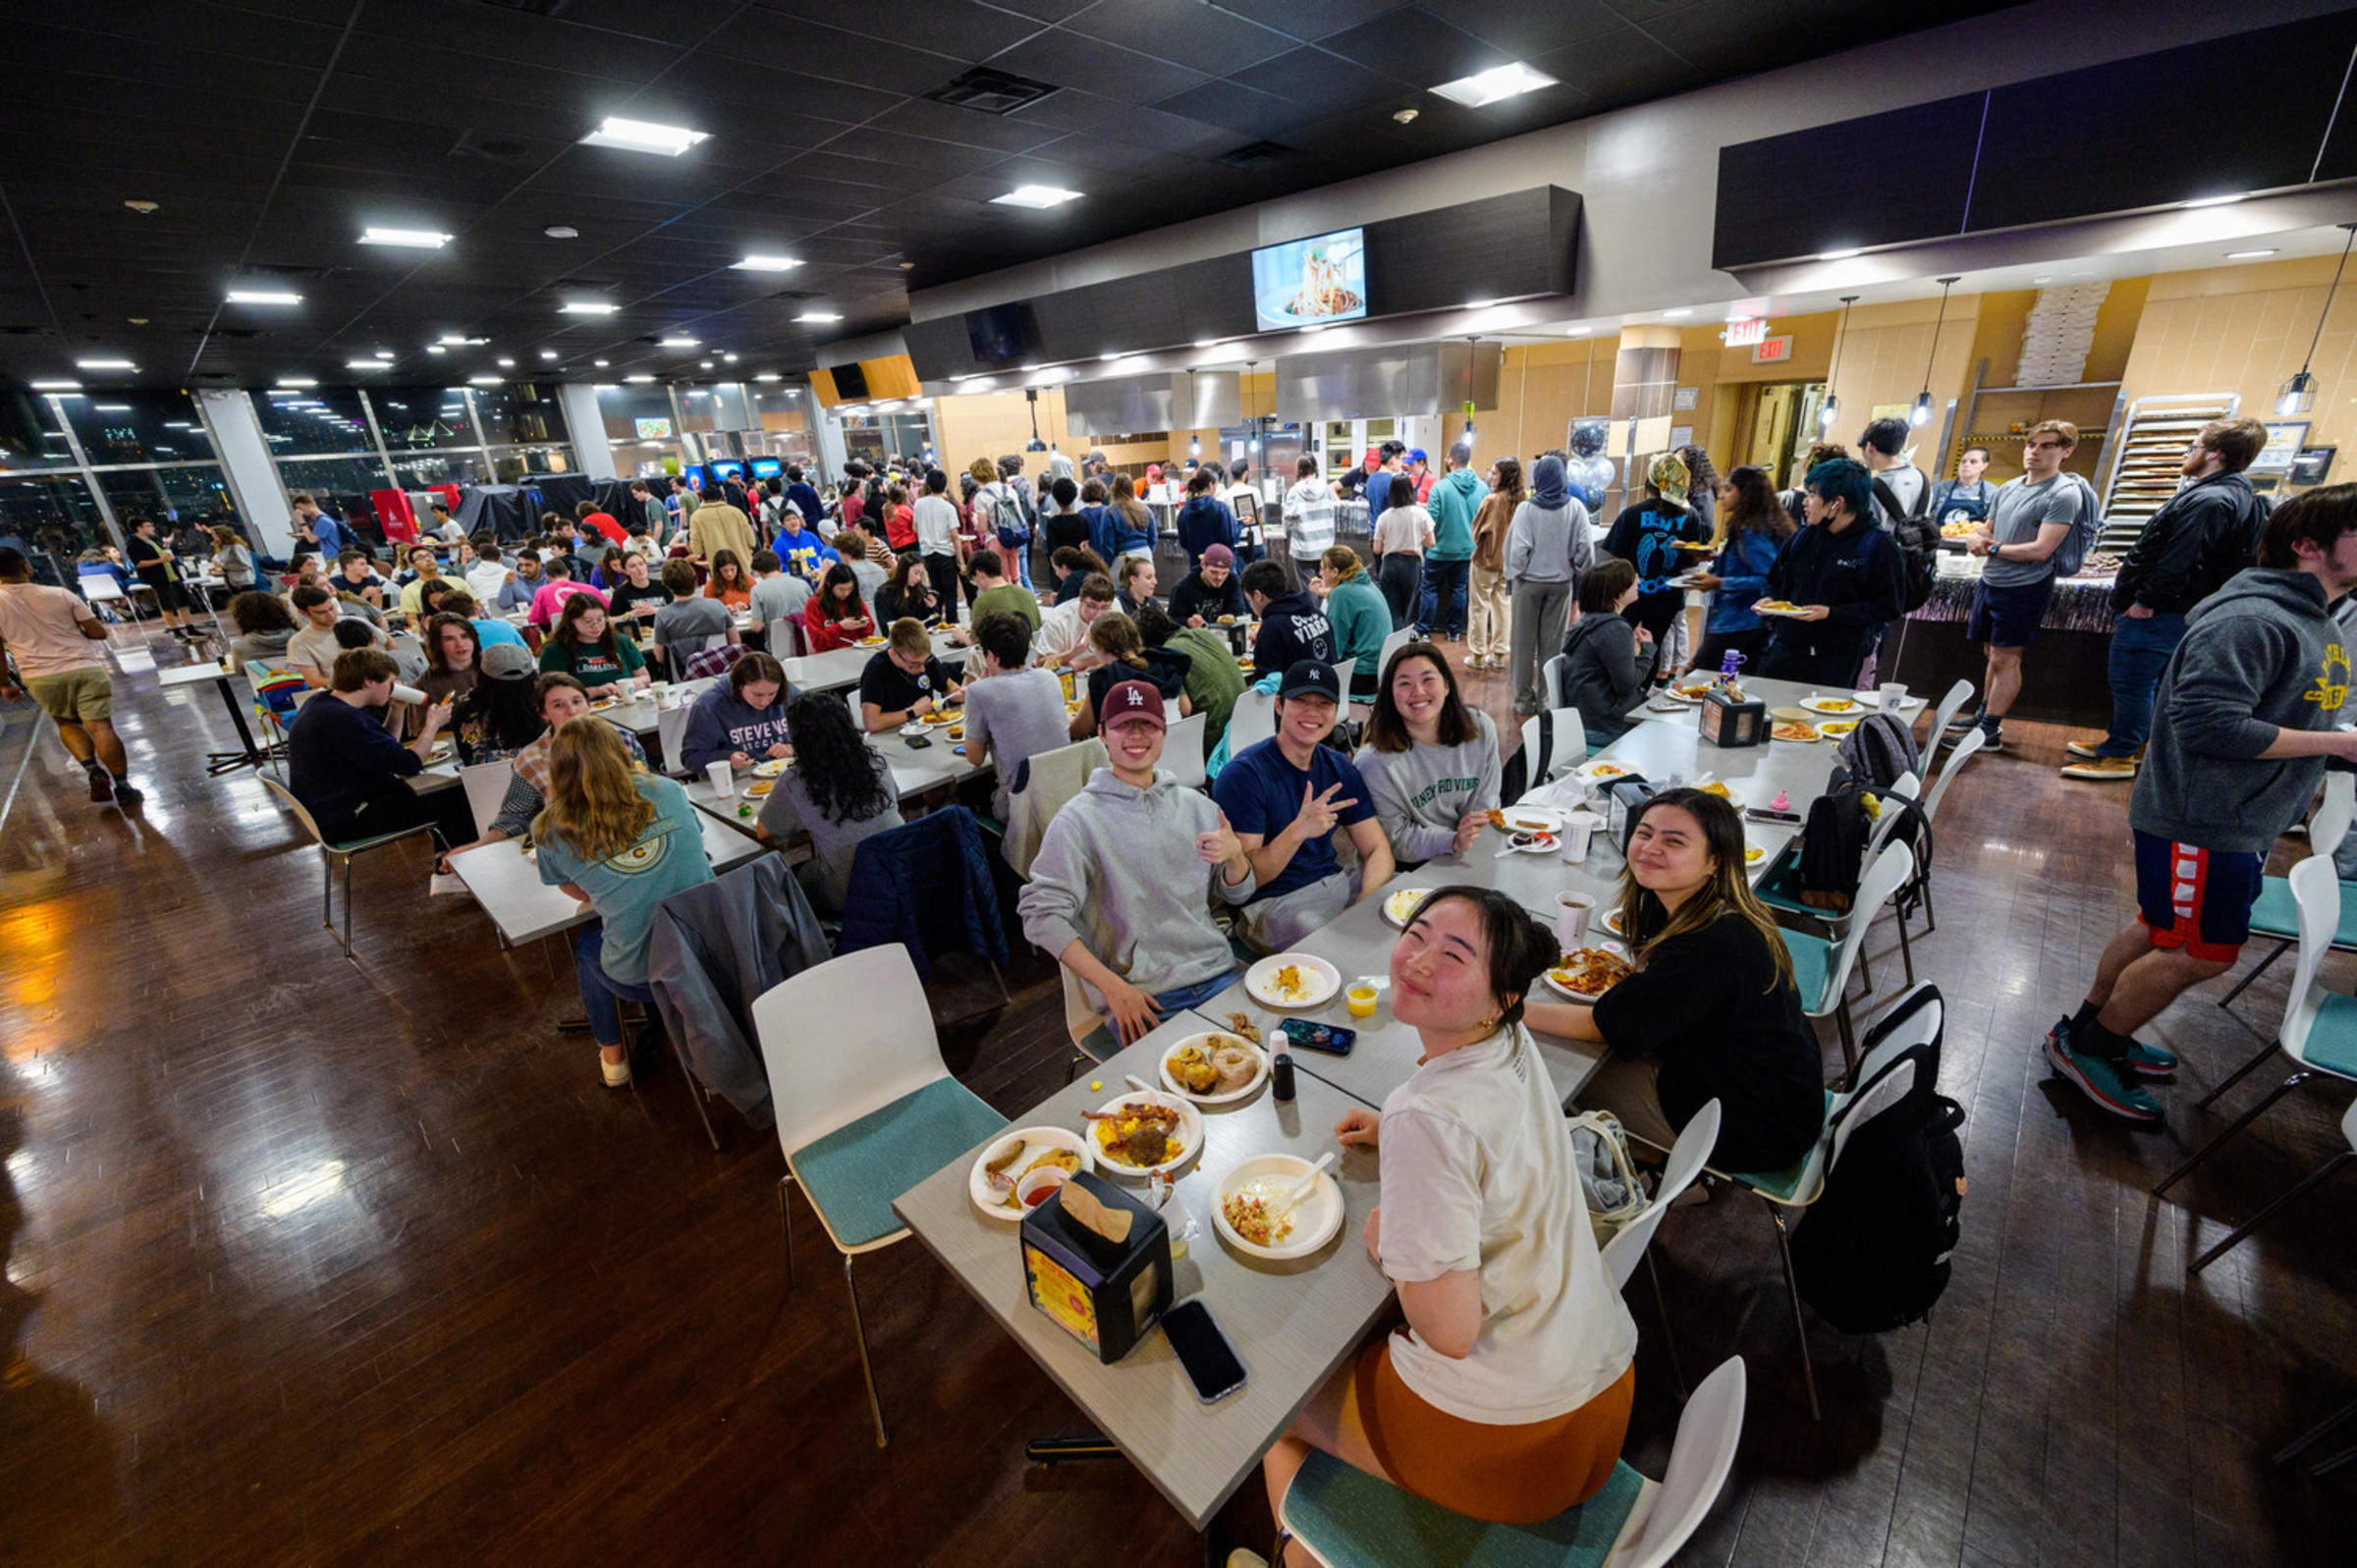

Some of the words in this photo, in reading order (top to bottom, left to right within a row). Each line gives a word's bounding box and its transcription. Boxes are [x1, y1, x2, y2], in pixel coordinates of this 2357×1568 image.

[1733, 319, 1763, 342] EXIT
[1759, 339, 1785, 360] EXIT
[1127, 686, 1143, 705] LA
